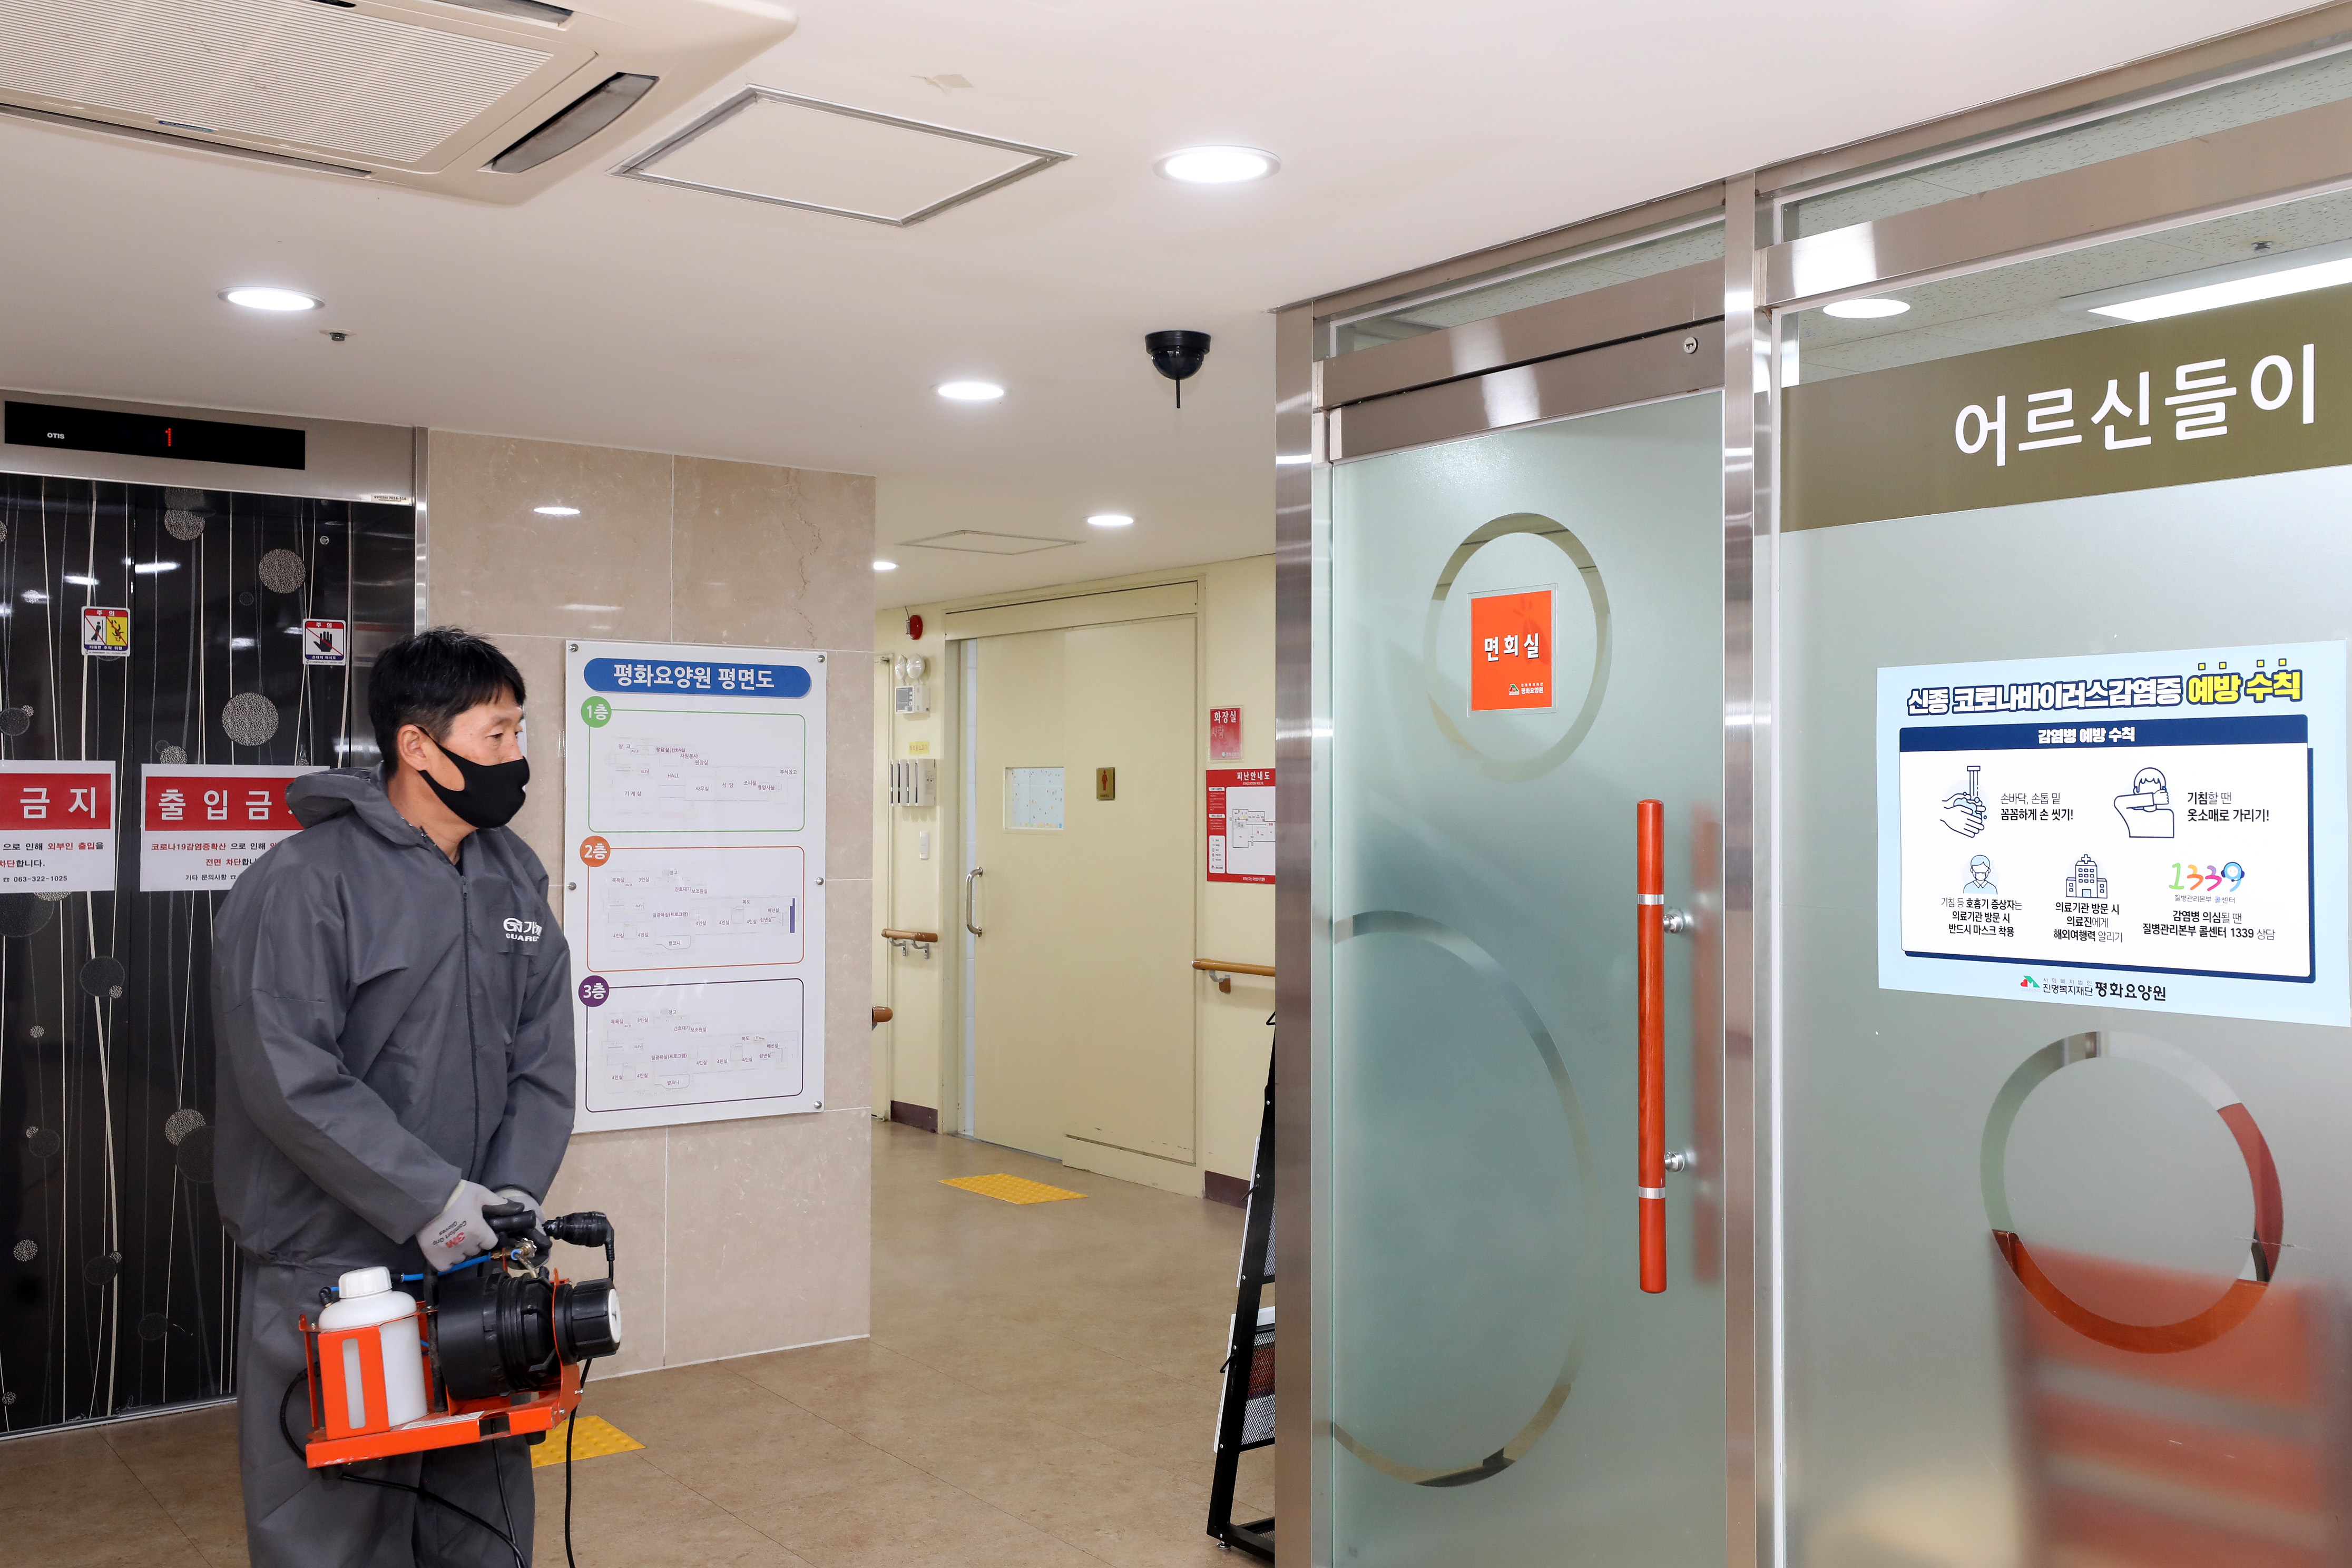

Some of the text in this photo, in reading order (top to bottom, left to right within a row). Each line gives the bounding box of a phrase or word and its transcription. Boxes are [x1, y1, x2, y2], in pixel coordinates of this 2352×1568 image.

[1955, 343, 2315, 467] 어르신들이
[165, 427, 171, 446] 1
[1484, 633, 1539, 662] 면회실
[614, 664, 775, 691] 평화요양원 평면도
[1907, 670, 2303, 716] 신종 코로나바이러스감염증 예방 수칙
[587, 703, 609, 720] 1층
[1214, 710, 1237, 724] 화장실
[2038, 727, 2135, 744] 감염병 예방 수칙
[1237, 771, 1270, 781] 피난안내도
[2001, 793, 2060, 805] 손바닥, 손톱 밑
[2188, 792, 2231, 805] 기침할 땐
[2001, 809, 2073, 821] 꼼꼼하게 손 씻기!
[2187, 809, 2269, 822] 옷소매로 가리기!
[78, 841, 104, 850] 출입을
[584, 843, 607, 859] 2층
[2169, 861, 2243, 892] 1339
[1941, 897, 2022, 910] 기침 등 호흡기 증상자는
[2055, 902, 2119, 915] 의료기관 방문 시
[1952, 911, 2010, 923] 의료기관 방문 시
[2067, 916, 2108, 928] 의료진에게
[2173, 910, 2242, 924] 감염병 의심될 땐
[1949, 924, 2014, 937] 반드시 마스크 착용
[2054, 929, 2122, 943] 해외여행력 알리기
[2143, 923, 2276, 940] 질병관리본부 콜센터 1339 상담
[583, 983, 606, 999] 3층
[2043, 981, 2166, 1002] 진명복지재단 평화요양원
[439, 1221, 457, 1236] Gloves
[445, 1220, 467, 1239] Comfort
[445, 1232, 465, 1248] 3M
